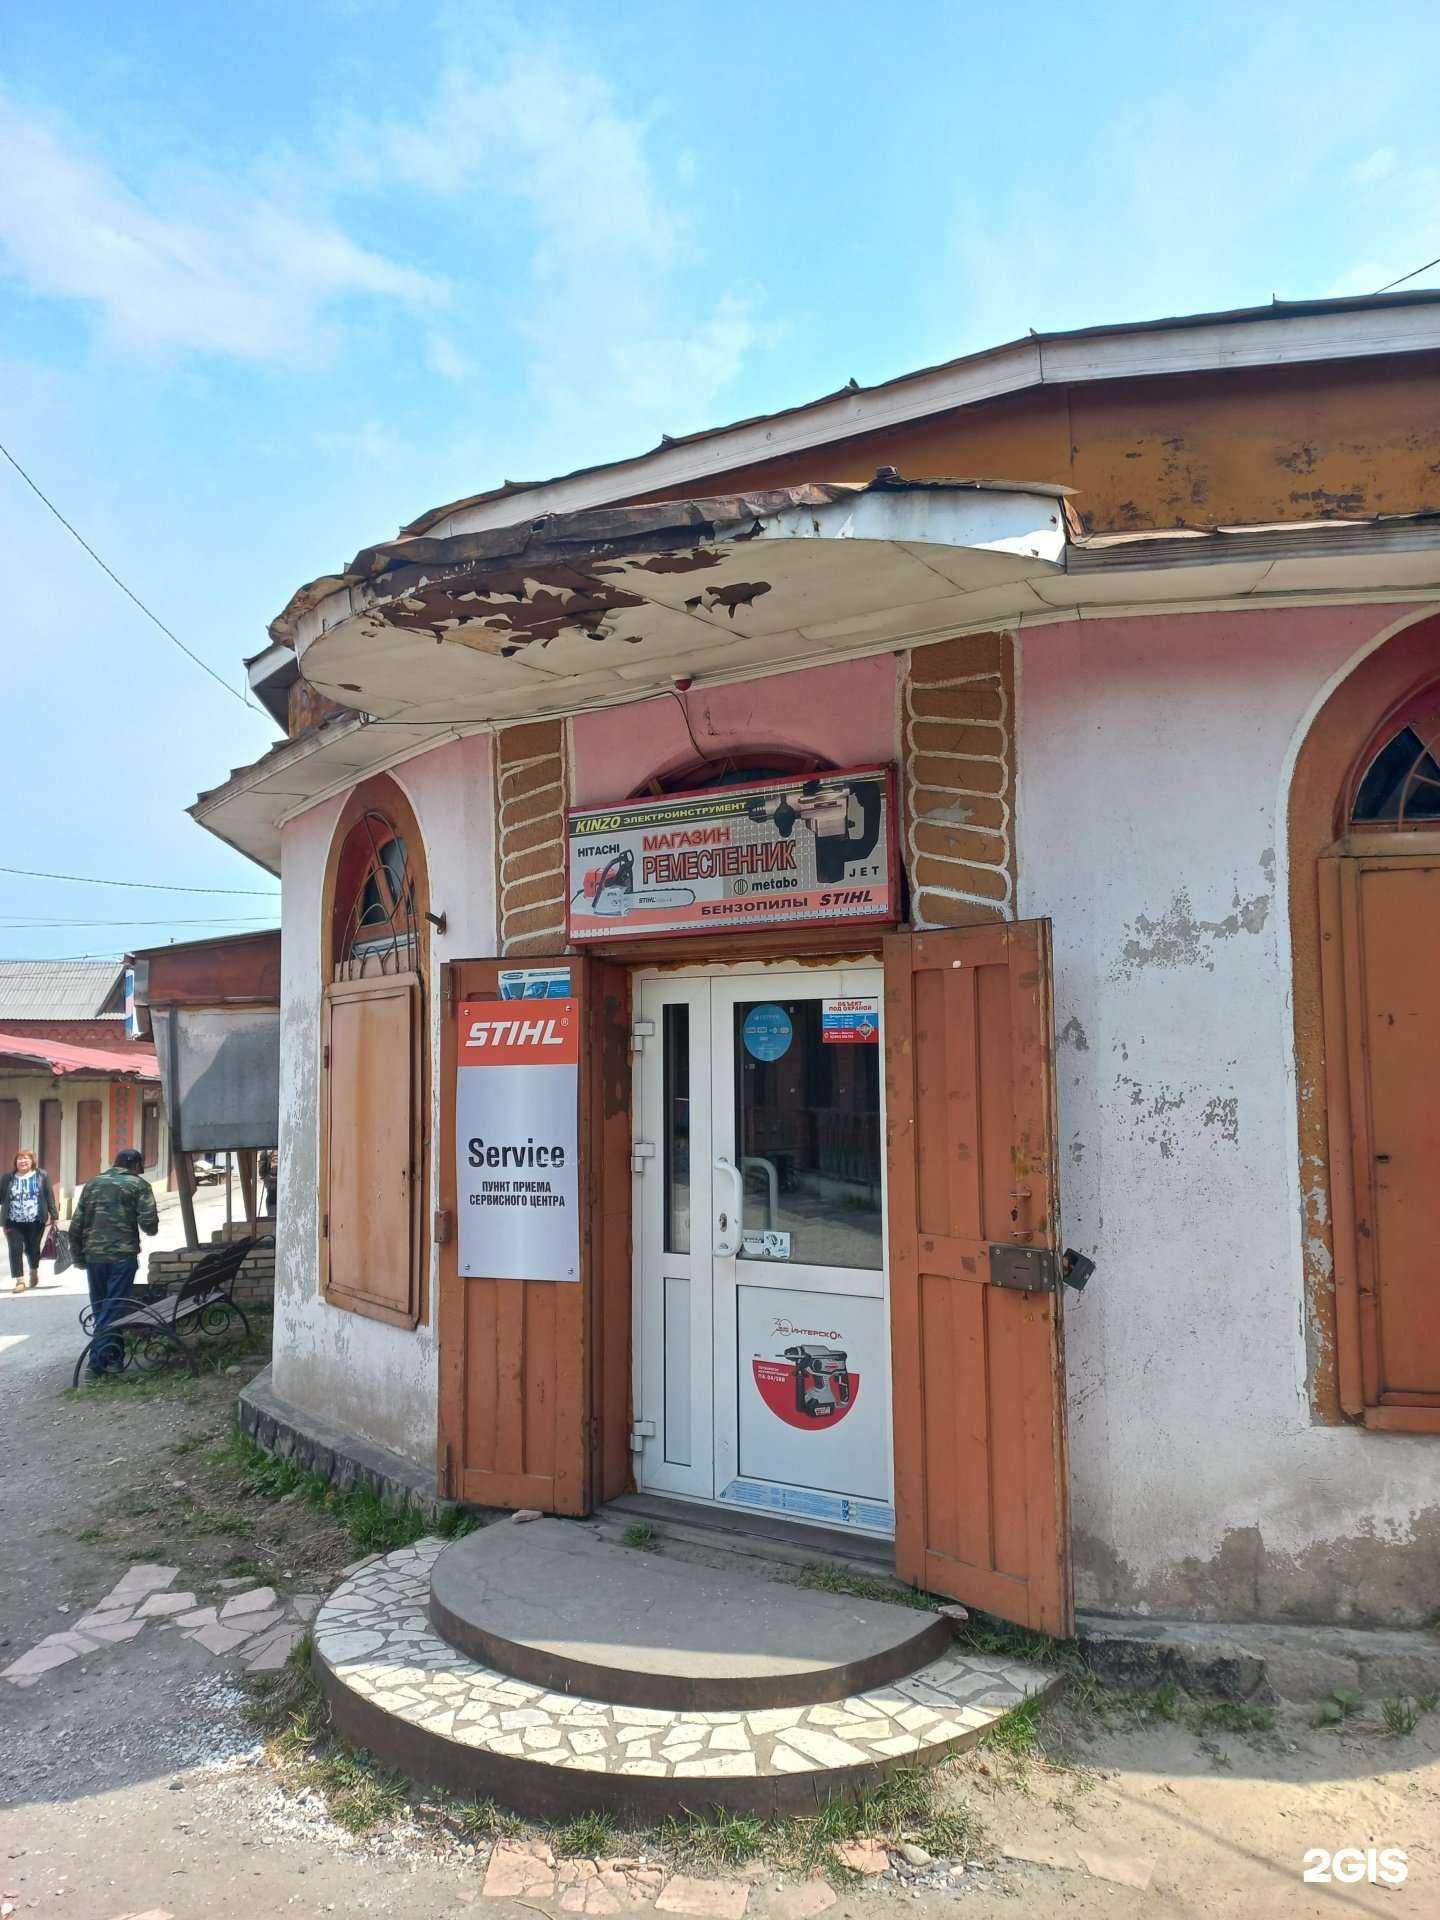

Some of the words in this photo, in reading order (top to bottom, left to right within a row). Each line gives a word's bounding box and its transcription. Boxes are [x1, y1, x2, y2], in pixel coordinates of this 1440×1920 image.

[623, 802, 747, 824] ЭЛЕКТРОИНСТРУМЕНТ
[575, 816, 621, 833] KINZO
[642, 826, 731, 850] МАГАЗИН
[577, 844, 620, 857] HITACHI
[642, 839, 798, 885] РЕМЕСЛЕННИК
[751, 877, 798, 891] metabo
[701, 897, 808, 915] БЕНЗОПИЛЫ
[819, 890, 873, 906] STIHL
[465, 1019, 564, 1047] STIHL
[468, 1137, 565, 1168] Service
[482, 1181, 510, 1192] ПУНКТ
[513, 1181, 551, 1193] ПРИЕМА
[469, 1194, 527, 1206] СЕРВИСНОГО
[530, 1195, 566, 1207] ЦЕНТРА
